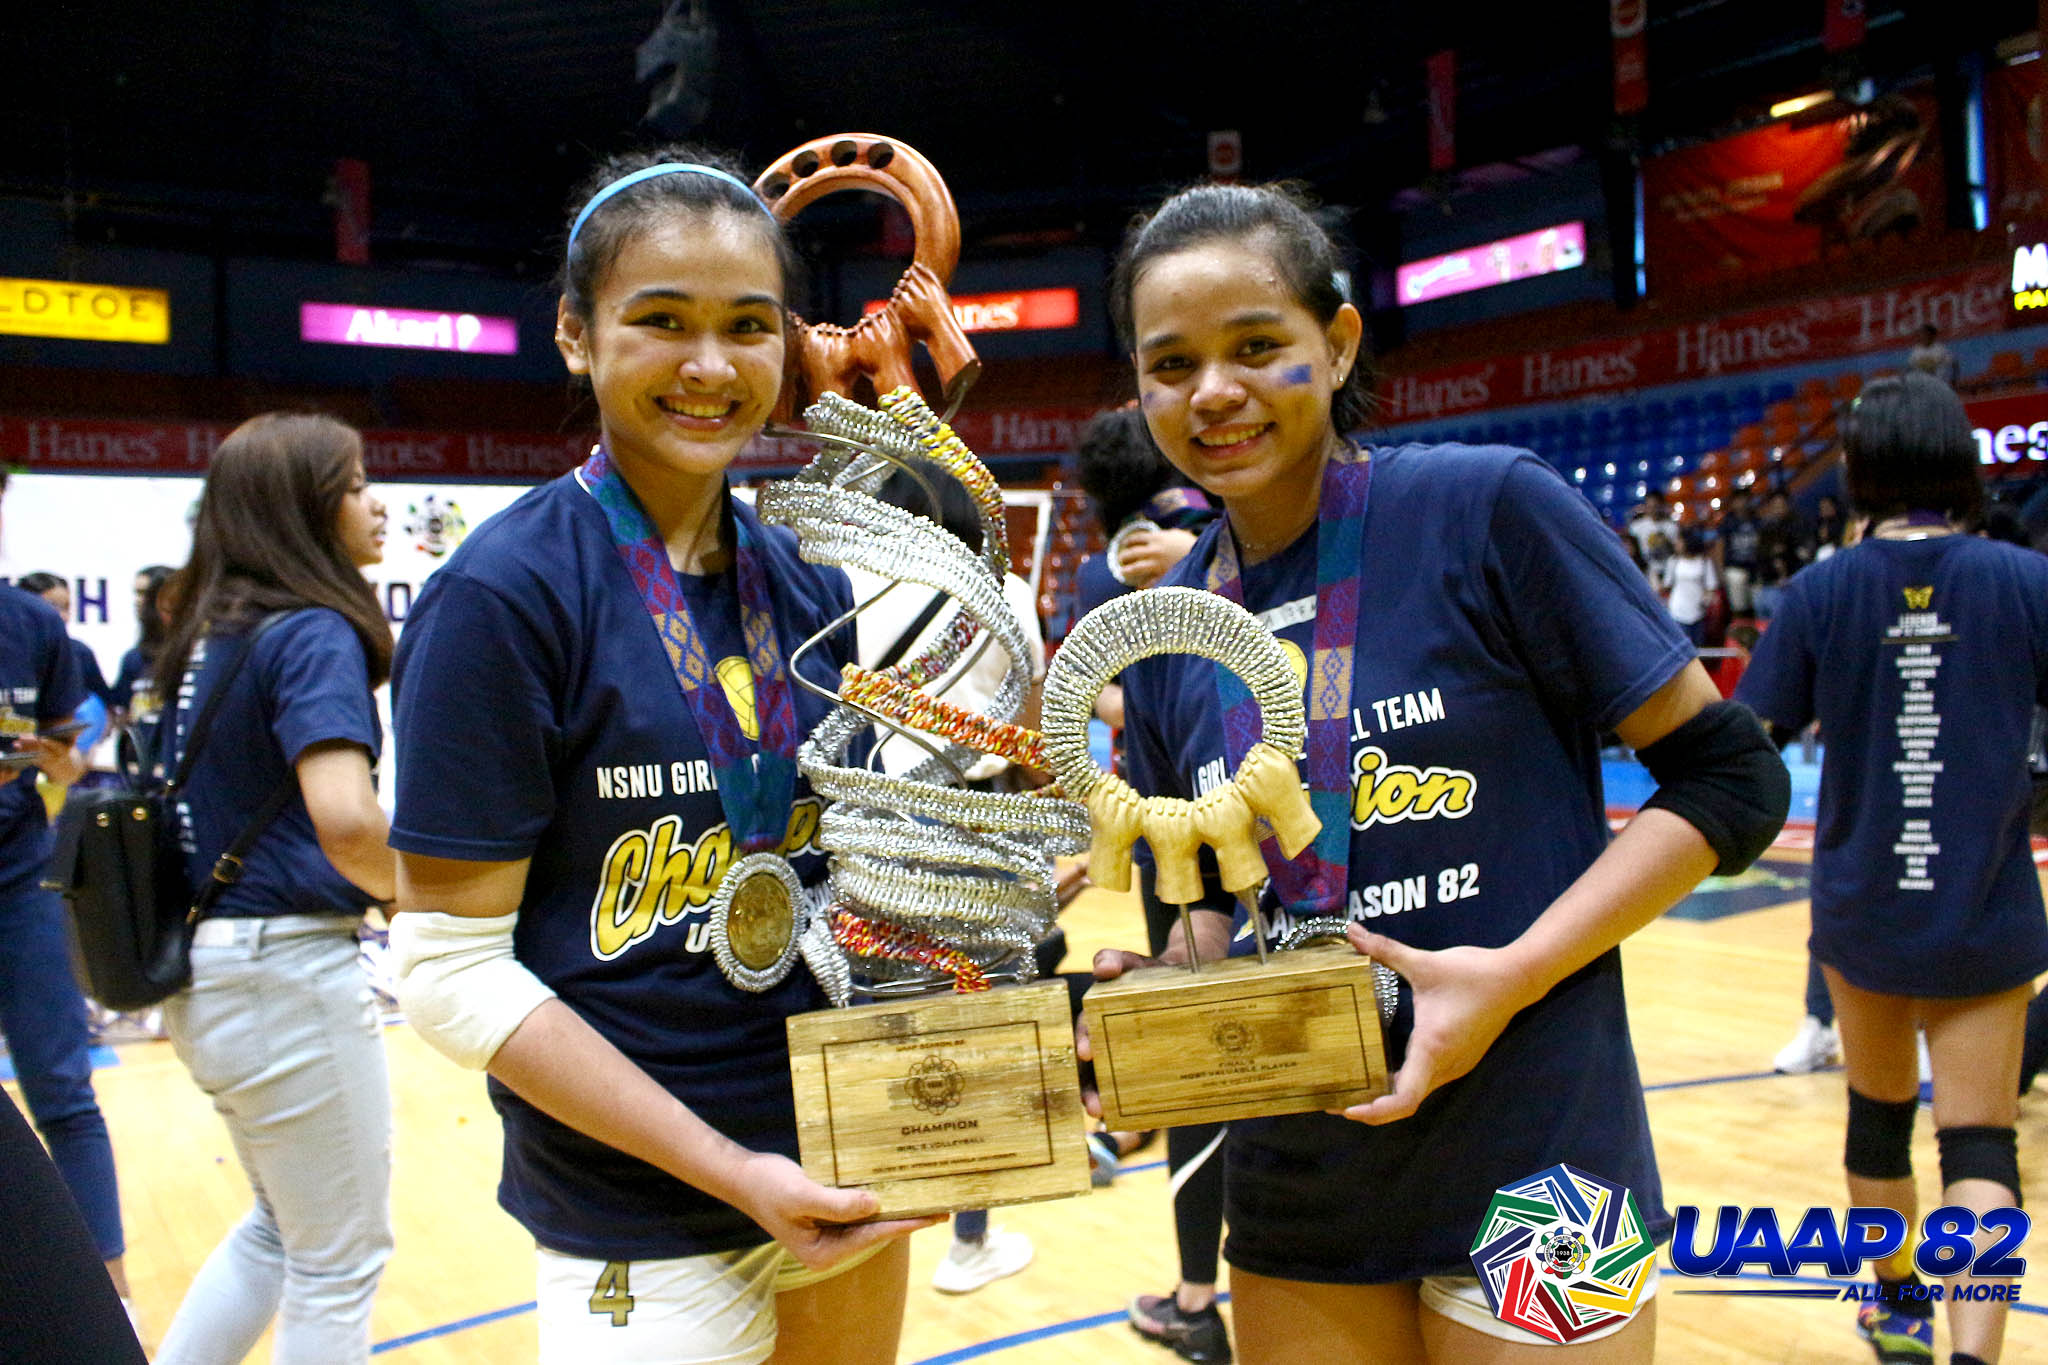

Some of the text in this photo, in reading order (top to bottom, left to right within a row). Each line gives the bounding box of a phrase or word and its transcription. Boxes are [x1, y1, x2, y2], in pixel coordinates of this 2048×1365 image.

[1970, 421, 2048, 465] nes
[1371, 688, 1446, 733] TEAM
[596, 763, 664, 799] NSNU
[1348, 863, 1480, 921] ASON 82
[901, 1119, 979, 1136] CHAMPION
[588, 1259, 635, 1327] 4
